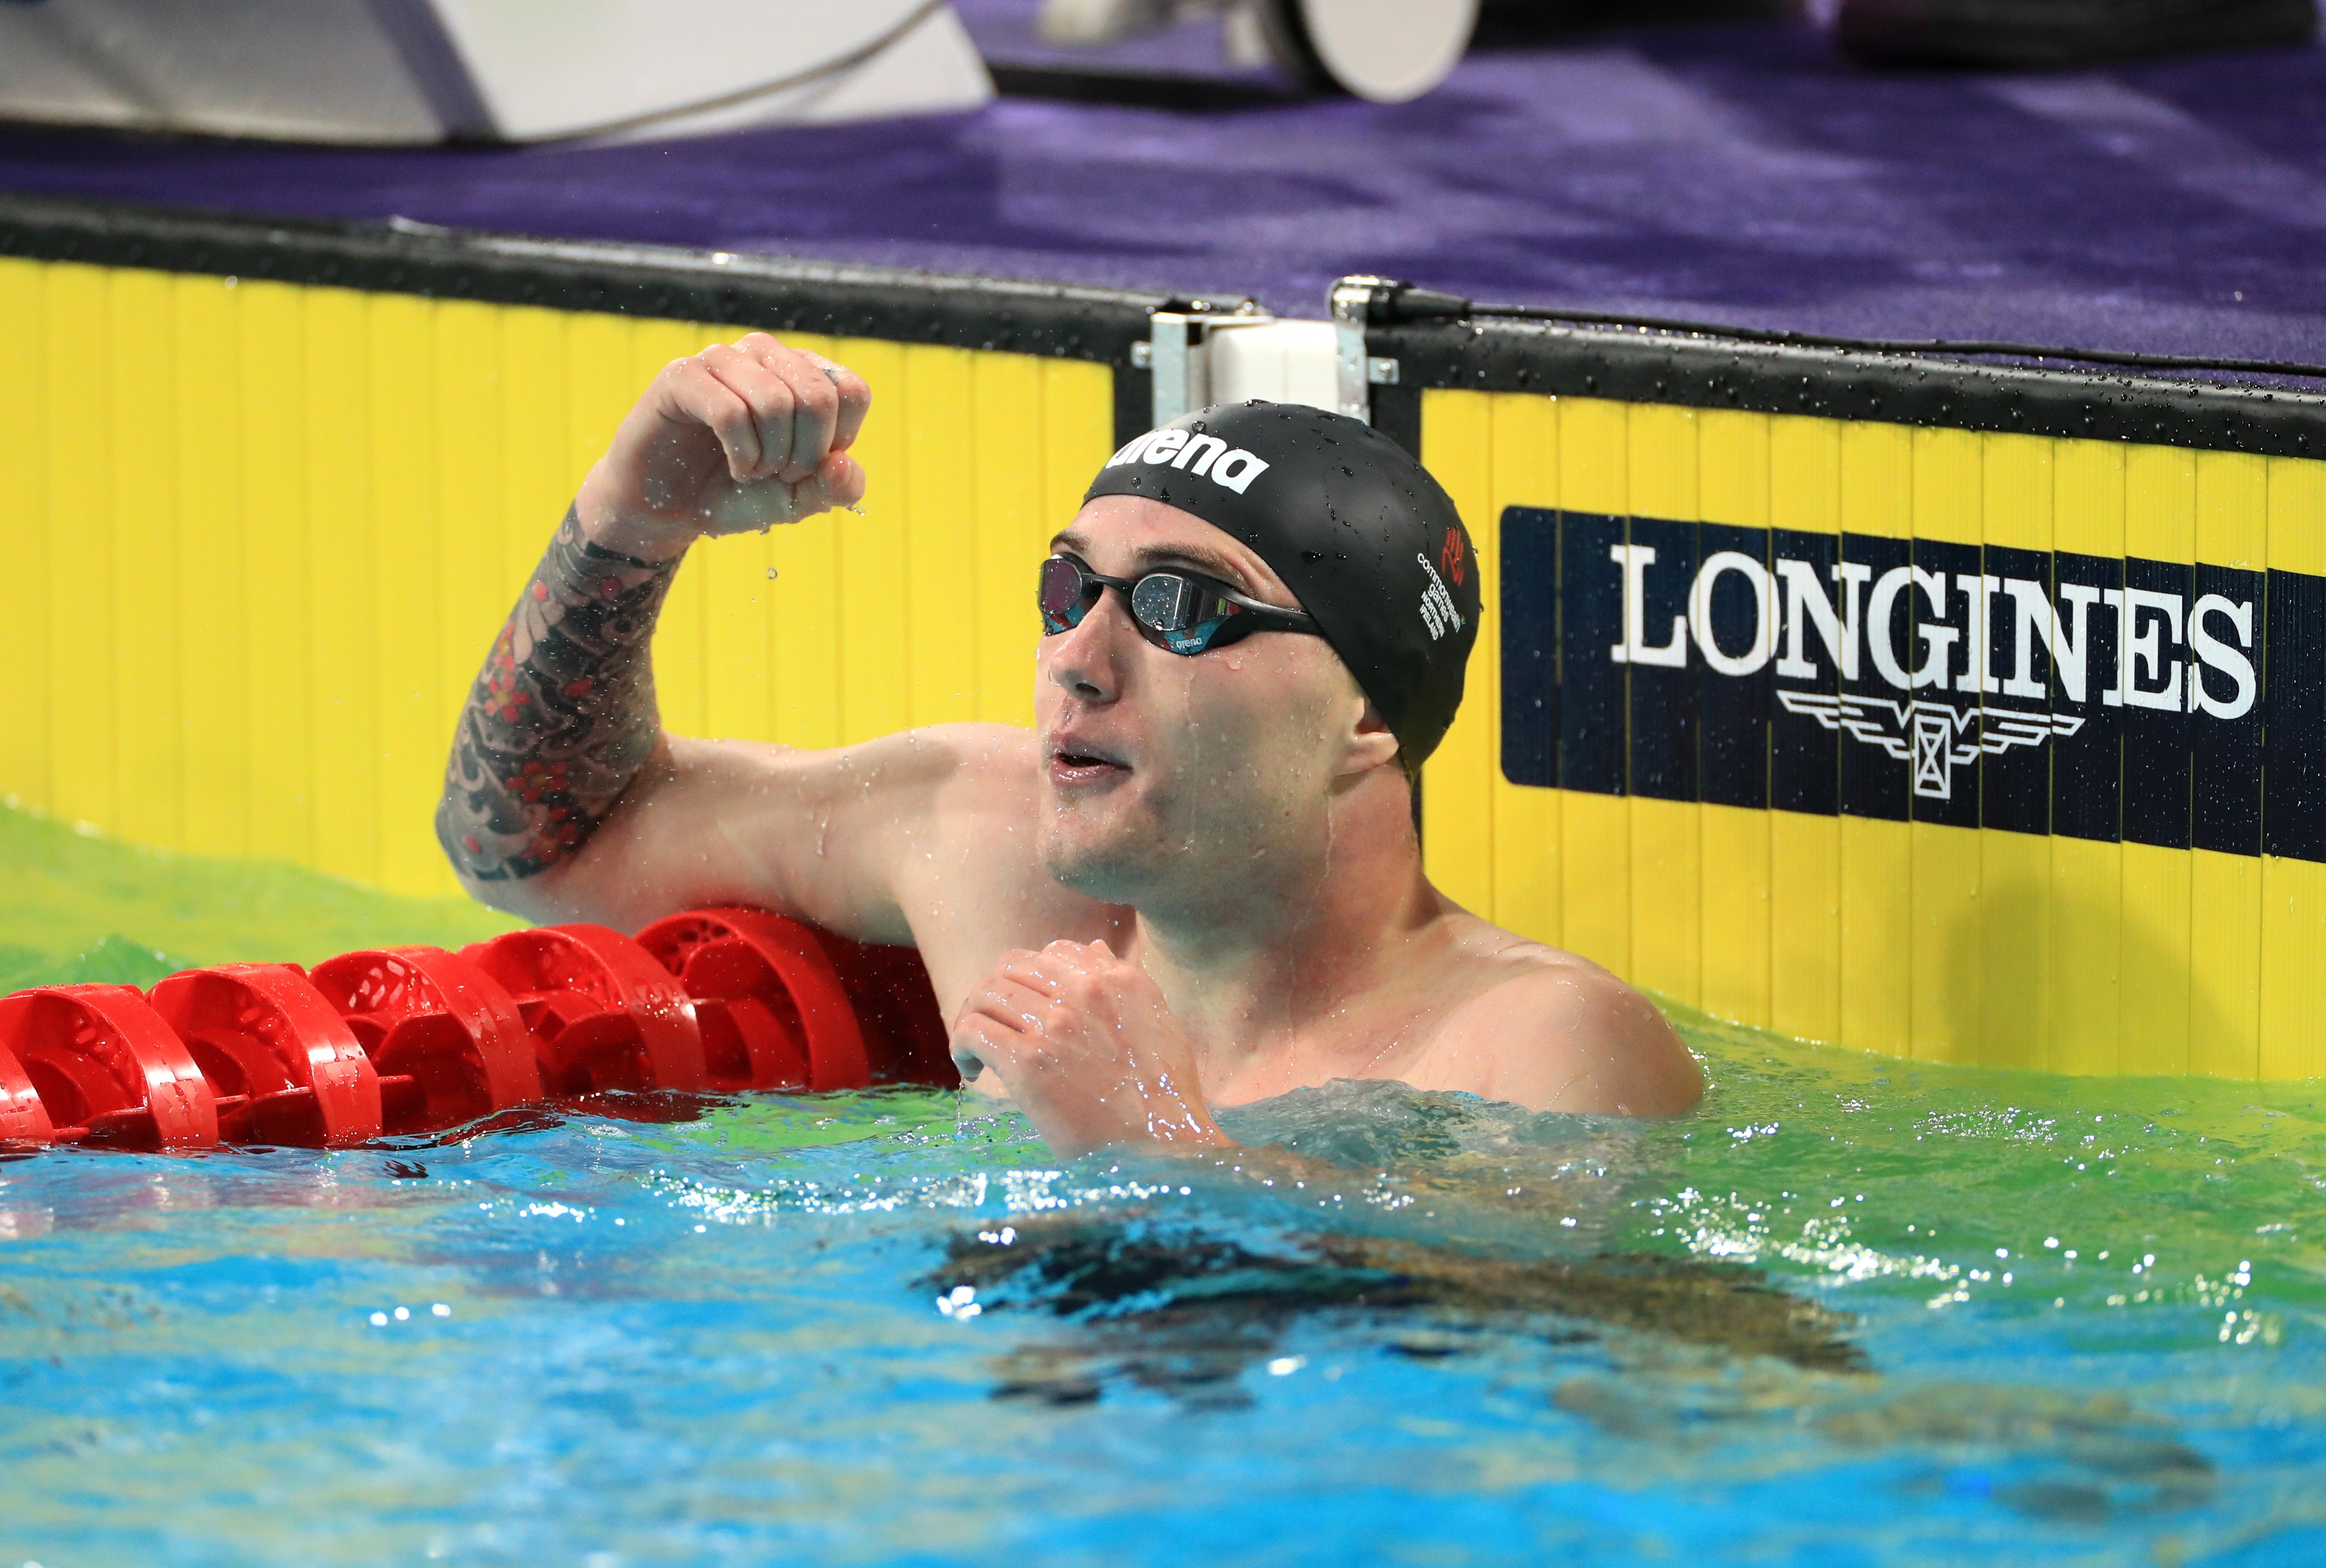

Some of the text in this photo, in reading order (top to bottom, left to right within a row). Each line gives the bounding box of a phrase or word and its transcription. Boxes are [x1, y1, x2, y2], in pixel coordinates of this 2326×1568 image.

[1106, 429, 1270, 495] arena
[1417, 553, 1461, 633] commonwealth
[1421, 591, 1445, 638] NORTHERN
[1427, 583, 1449, 622] games
[1176, 637, 1203, 648] arena
[1419, 604, 1439, 641] IRELAND
[1610, 545, 2257, 721] LONGINES
